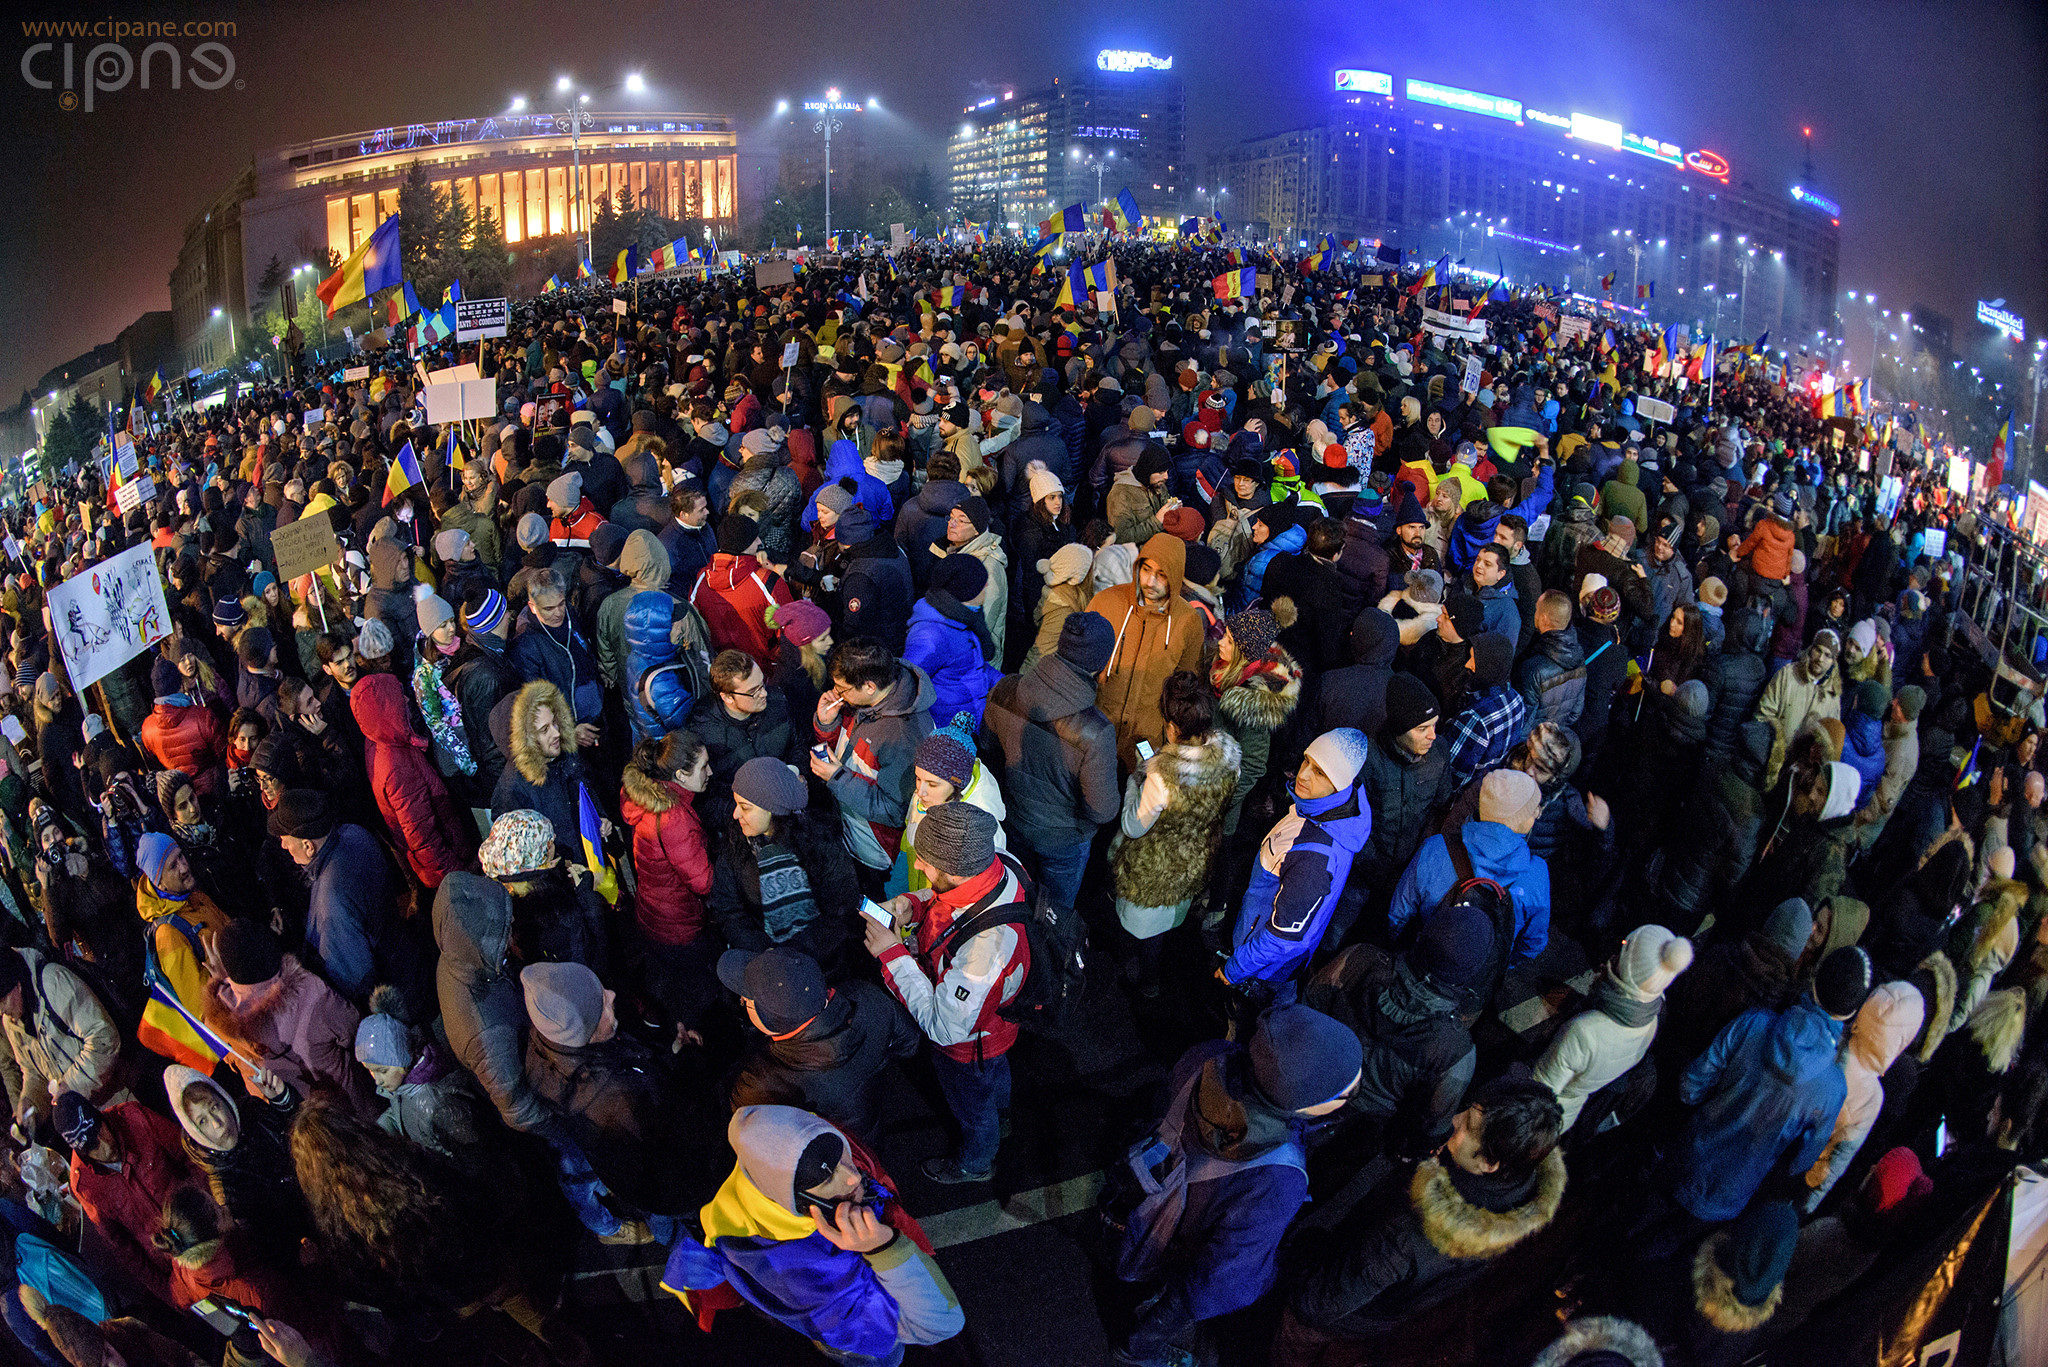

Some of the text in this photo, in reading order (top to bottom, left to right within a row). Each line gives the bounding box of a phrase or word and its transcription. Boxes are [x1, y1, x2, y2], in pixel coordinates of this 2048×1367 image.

[669, 268, 682, 277] FOR
[684, 266, 723, 275] DEMORAC
[1977, 300, 2024, 331] DentalMed
